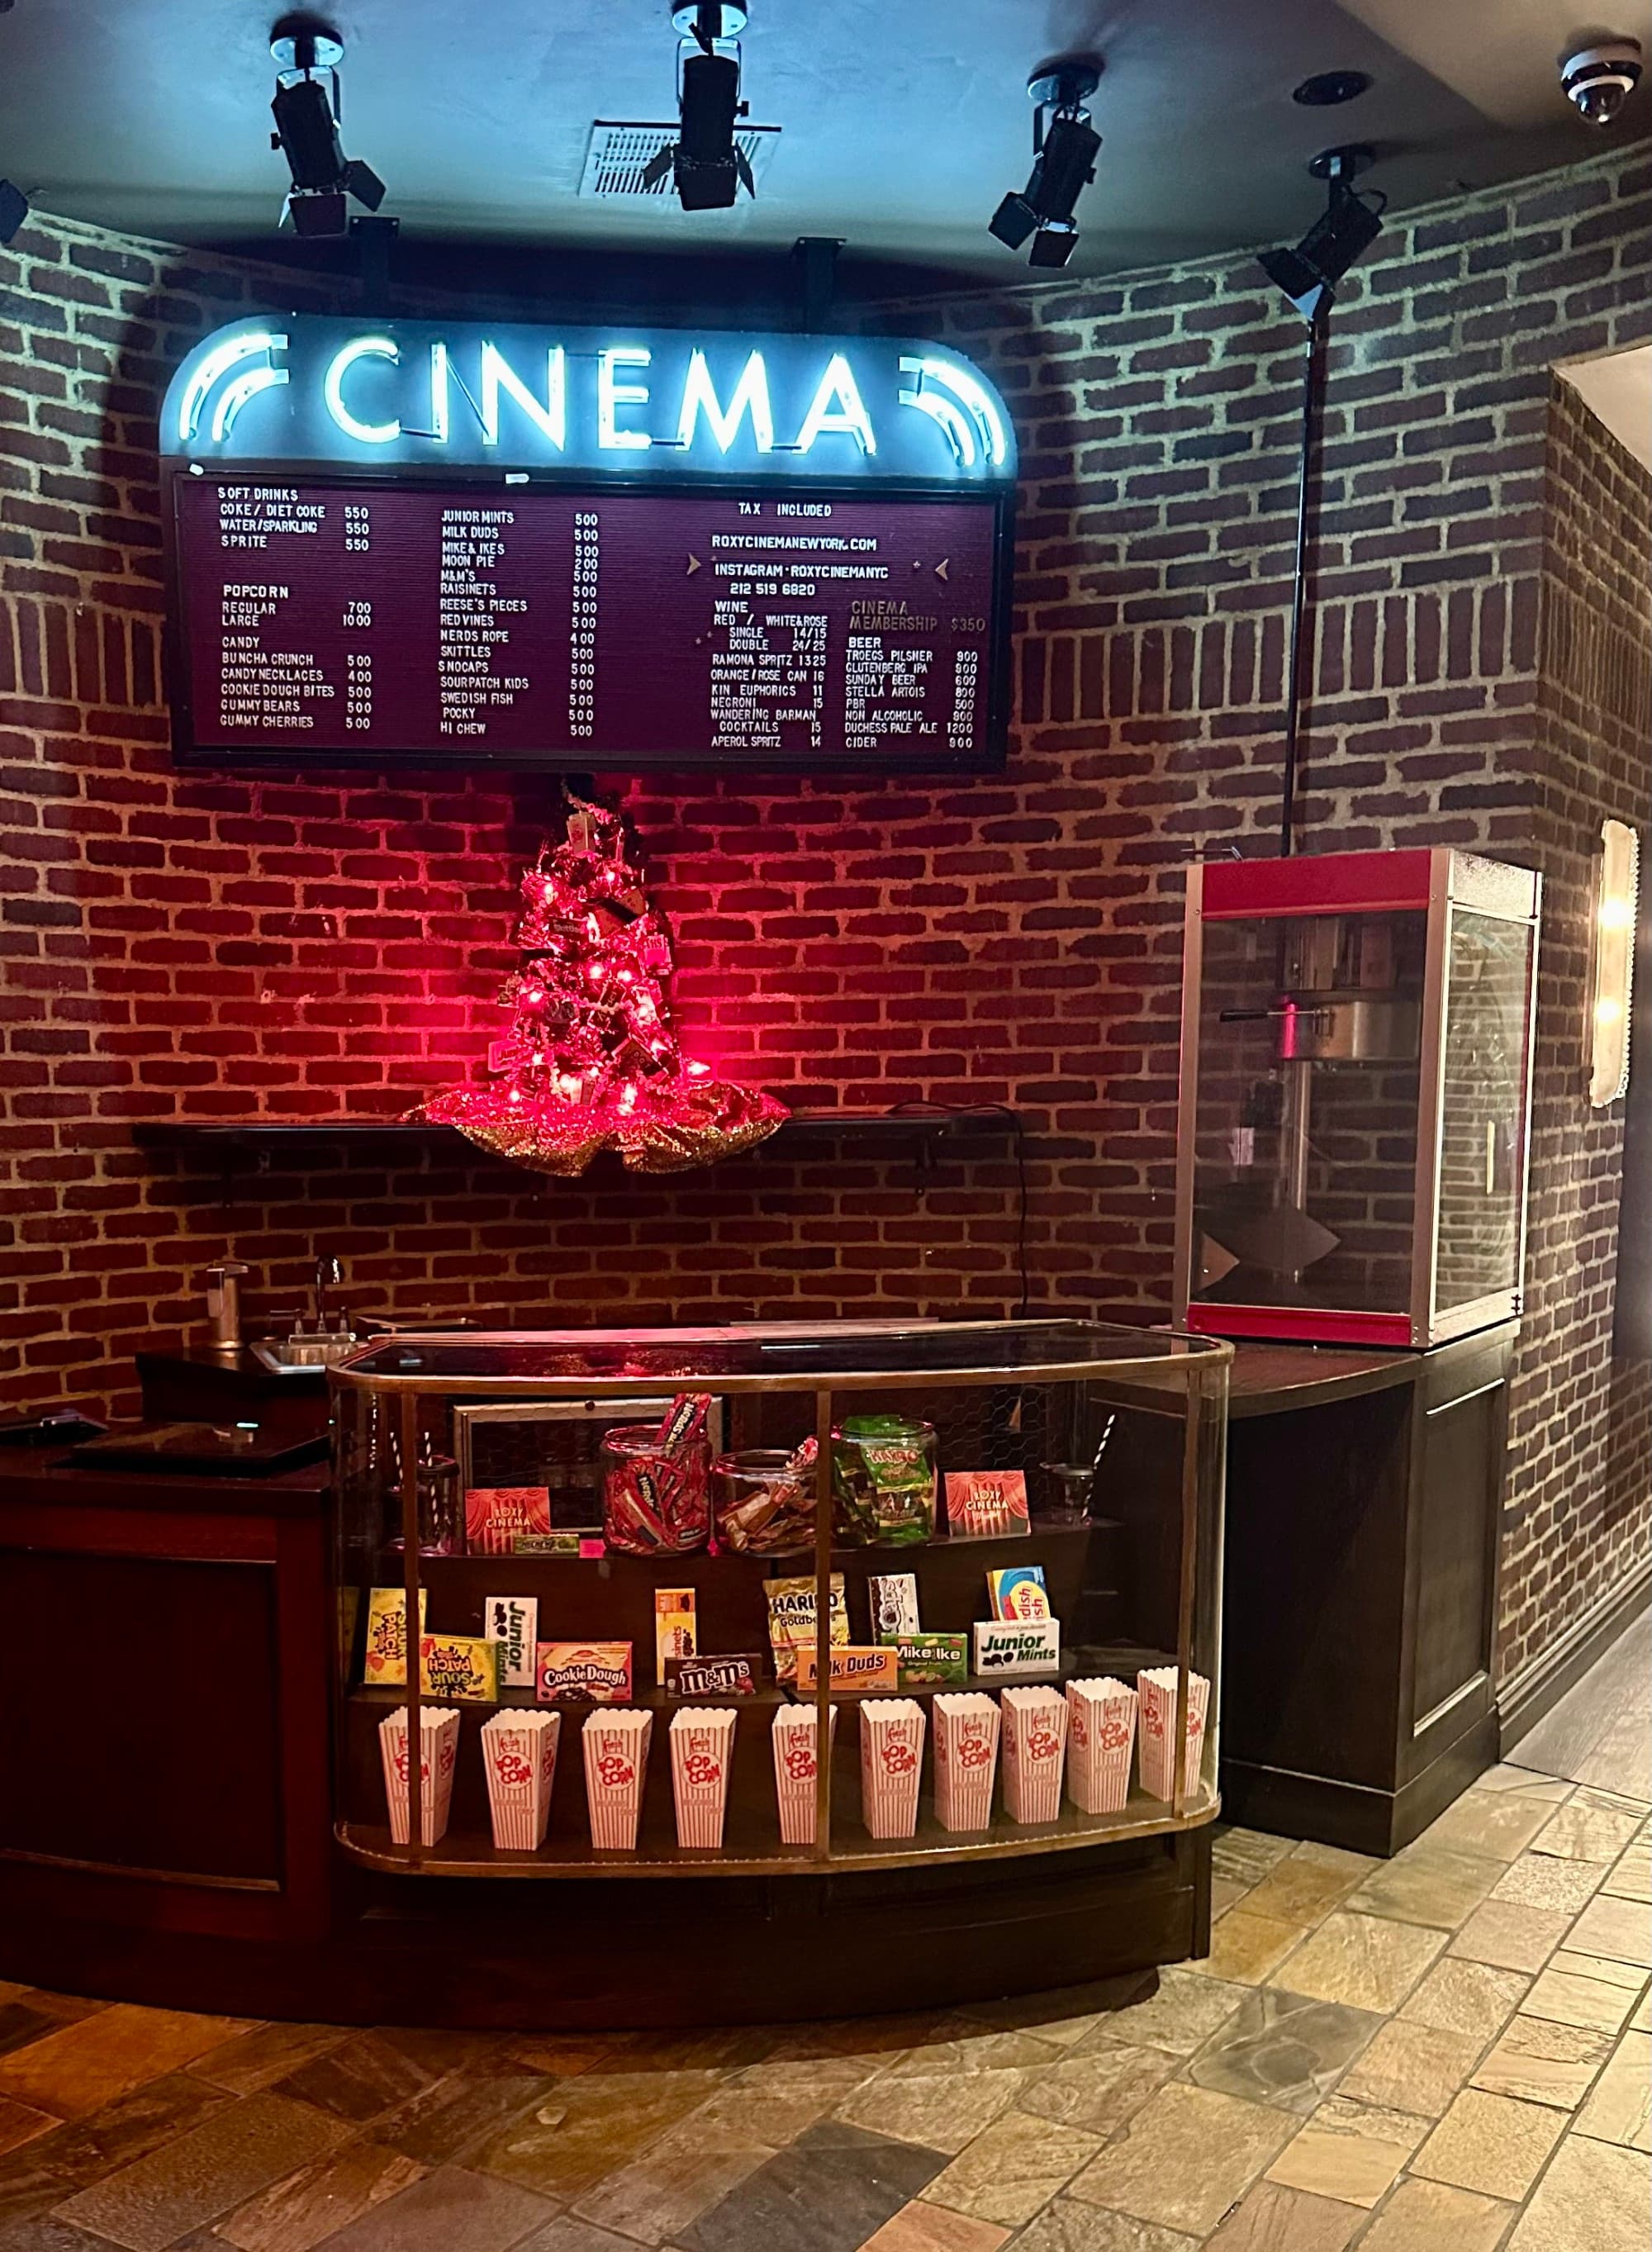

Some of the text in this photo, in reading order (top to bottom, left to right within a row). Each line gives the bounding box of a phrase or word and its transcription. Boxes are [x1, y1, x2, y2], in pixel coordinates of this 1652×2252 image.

[323, 335, 877, 458] CINEMA
[218, 487, 298, 501] SOFT DRINKS
[267, 505, 369, 519] DIET COKE 550
[738, 502, 832, 516] TAX INCLUDED
[441, 511, 598, 526] JUNIOR MINTS 500
[346, 523, 369, 534] 550
[442, 526, 598, 541] MILK DUDS 500
[221, 535, 369, 551] SPRITE 550
[479, 543, 599, 557] IKES 500
[442, 555, 598, 570] MOON PIE 200
[441, 569, 597, 582] M&M'S 500
[223, 585, 288, 598] POPCORN
[440, 582, 596, 597] RAISINETS 500
[730, 583, 815, 596] 212 519 6820
[222, 601, 371, 615] REGULAR 700
[440, 597, 597, 613] REESE'S PIECES 500
[714, 600, 748, 613] WINE
[852, 601, 909, 615] CINEMA
[222, 615, 371, 626] LARGE 1000
[440, 614, 596, 629] RED VINES 500
[714, 614, 736, 625] RED
[849, 615, 985, 631] MEMBERSHIP $350
[440, 630, 595, 644] NERDS ROPE 400
[729, 627, 827, 639] SINGLE 14/15
[222, 637, 259, 649] CANDY
[729, 639, 769, 650] DOUBLE
[848, 637, 881, 649] BEER
[440, 645, 593, 659] SKITTLES 500
[890, 650, 933, 662] PILSNER
[957, 651, 978, 662] 900
[222, 652, 371, 668] BUNCHA CRUNCH 500
[712, 653, 754, 666] RAMONA
[758, 654, 793, 668] SPRITZ
[221, 668, 372, 682] CANDY NECKLACES 400
[571, 663, 595, 675] 500
[914, 663, 928, 673] IPA
[787, 670, 824, 682] CAN 16
[846, 674, 885, 686] SUNDAY
[891, 674, 916, 686] BEER
[221, 683, 372, 698] COOKIE DOUGH BITES 500
[504, 677, 593, 691] KIDS 500
[711, 684, 823, 696] KIN EUPHORICS 11
[440, 692, 593, 706] SWEDISH FISH 500
[846, 687, 885, 697] STELLA
[891, 687, 925, 698] ARTOIS
[221, 700, 372, 714] GUMMY BEARS 500
[711, 696, 824, 709] NEGRONI 15
[846, 698, 974, 710] PBR 500
[443, 707, 593, 721] POCKY 500
[710, 708, 816, 721] WANDERING BARMAN
[845, 710, 923, 721] NON ALCOHOLIC
[221, 715, 370, 729] GUMMY CHERRIES 500
[440, 722, 592, 736] HI CHEW 500
[719, 721, 821, 733] COCKTAILS 15
[845, 722, 973, 734] DUCHESS PALE ALE 1200
[711, 736, 821, 748] APEROL SPRITZ 14
[846, 737, 877, 748] CIDER
[966, 1500, 1009, 1510] CINEMA
[486, 1518, 531, 1527] CINEMA
[772, 1592, 838, 1613] HARIO
[509, 1601, 525, 1672] Junior
[981, 1632, 1046, 1652] Junior
[937, 1648, 961, 1660] Ike
[1017, 1649, 1056, 1661] Mints
[429, 1657, 471, 1671] PATCH
[847, 1653, 885, 1672] Duds
[431, 1671, 472, 1684] SOUR
[544, 1665, 626, 1685] Cookie Dough
[1028, 1732, 1051, 1748] POP
[882, 1746, 906, 1762] POP
[958, 1739, 981, 1756] POP
[598, 1756, 624, 1774] POP
[685, 1755, 710, 1773] POP
[786, 1751, 810, 1768] POP
